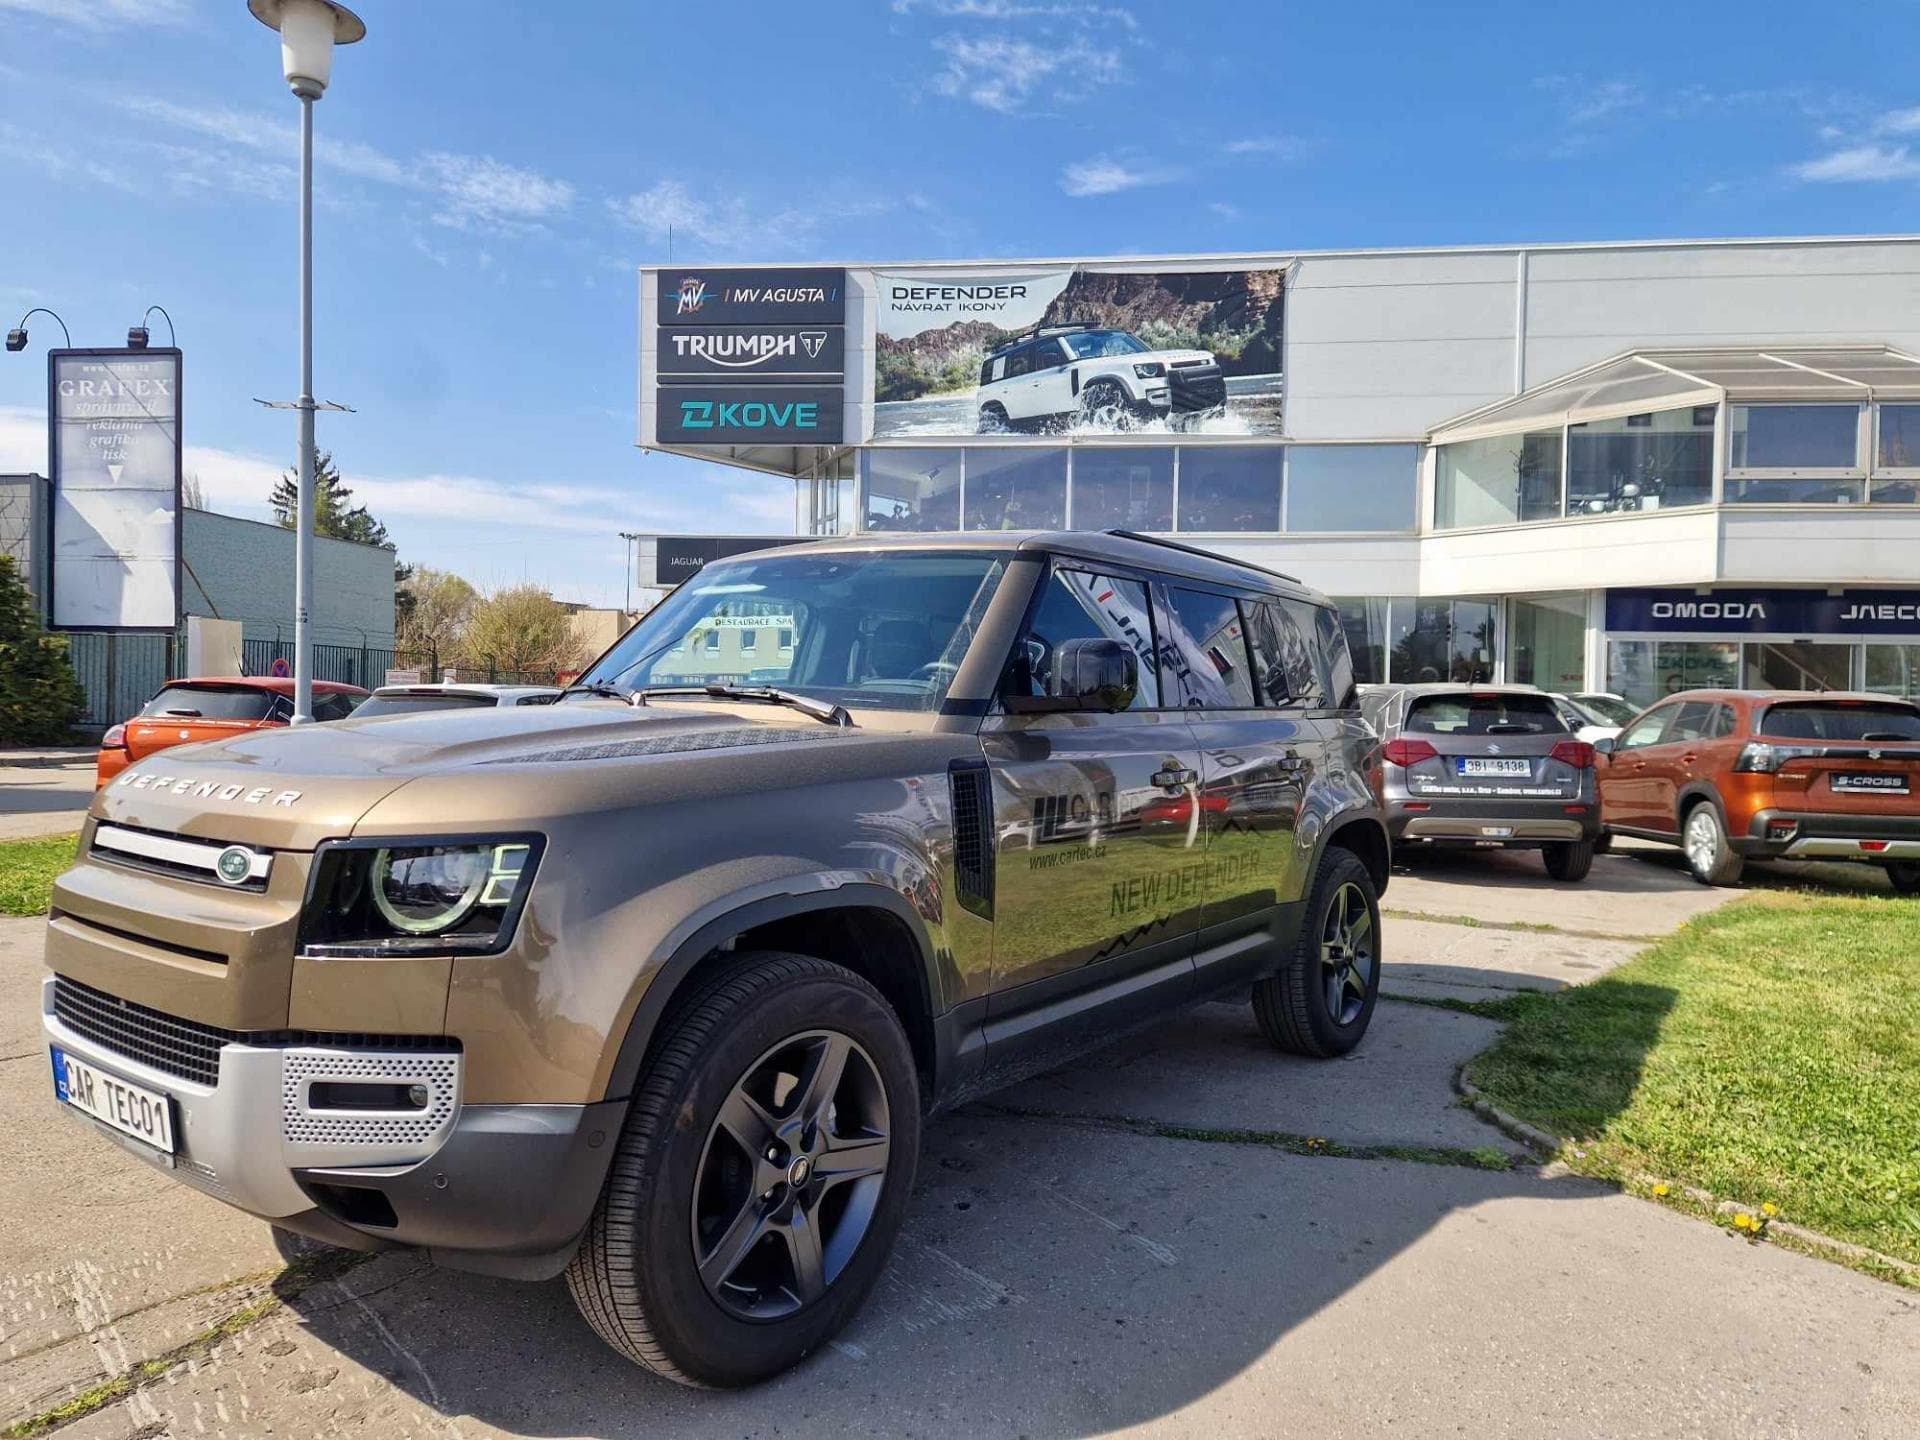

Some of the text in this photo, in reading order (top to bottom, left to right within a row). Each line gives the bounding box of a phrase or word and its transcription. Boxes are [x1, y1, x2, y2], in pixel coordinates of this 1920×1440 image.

[733, 288, 825, 303] MV AGUSTA
[892, 286, 1027, 300] DEFENDER
[891, 301, 1006, 312] NÁVRAT IKONY
[672, 335, 796, 366] TRIUMPH
[103, 448, 128, 461] tisk
[670, 557, 704, 567] JAGUAR
[1652, 602, 1767, 619] OMODA
[1840, 604, 1920, 620] JAEC
[1496, 761, 1525, 773] 9138
[1837, 776, 1903, 787] S-CROSS
[118, 773, 304, 808] DEFENDER
[1110, 849, 1261, 918] NEW DEFENDER
[65, 1060, 167, 1144] CAR TEC01
